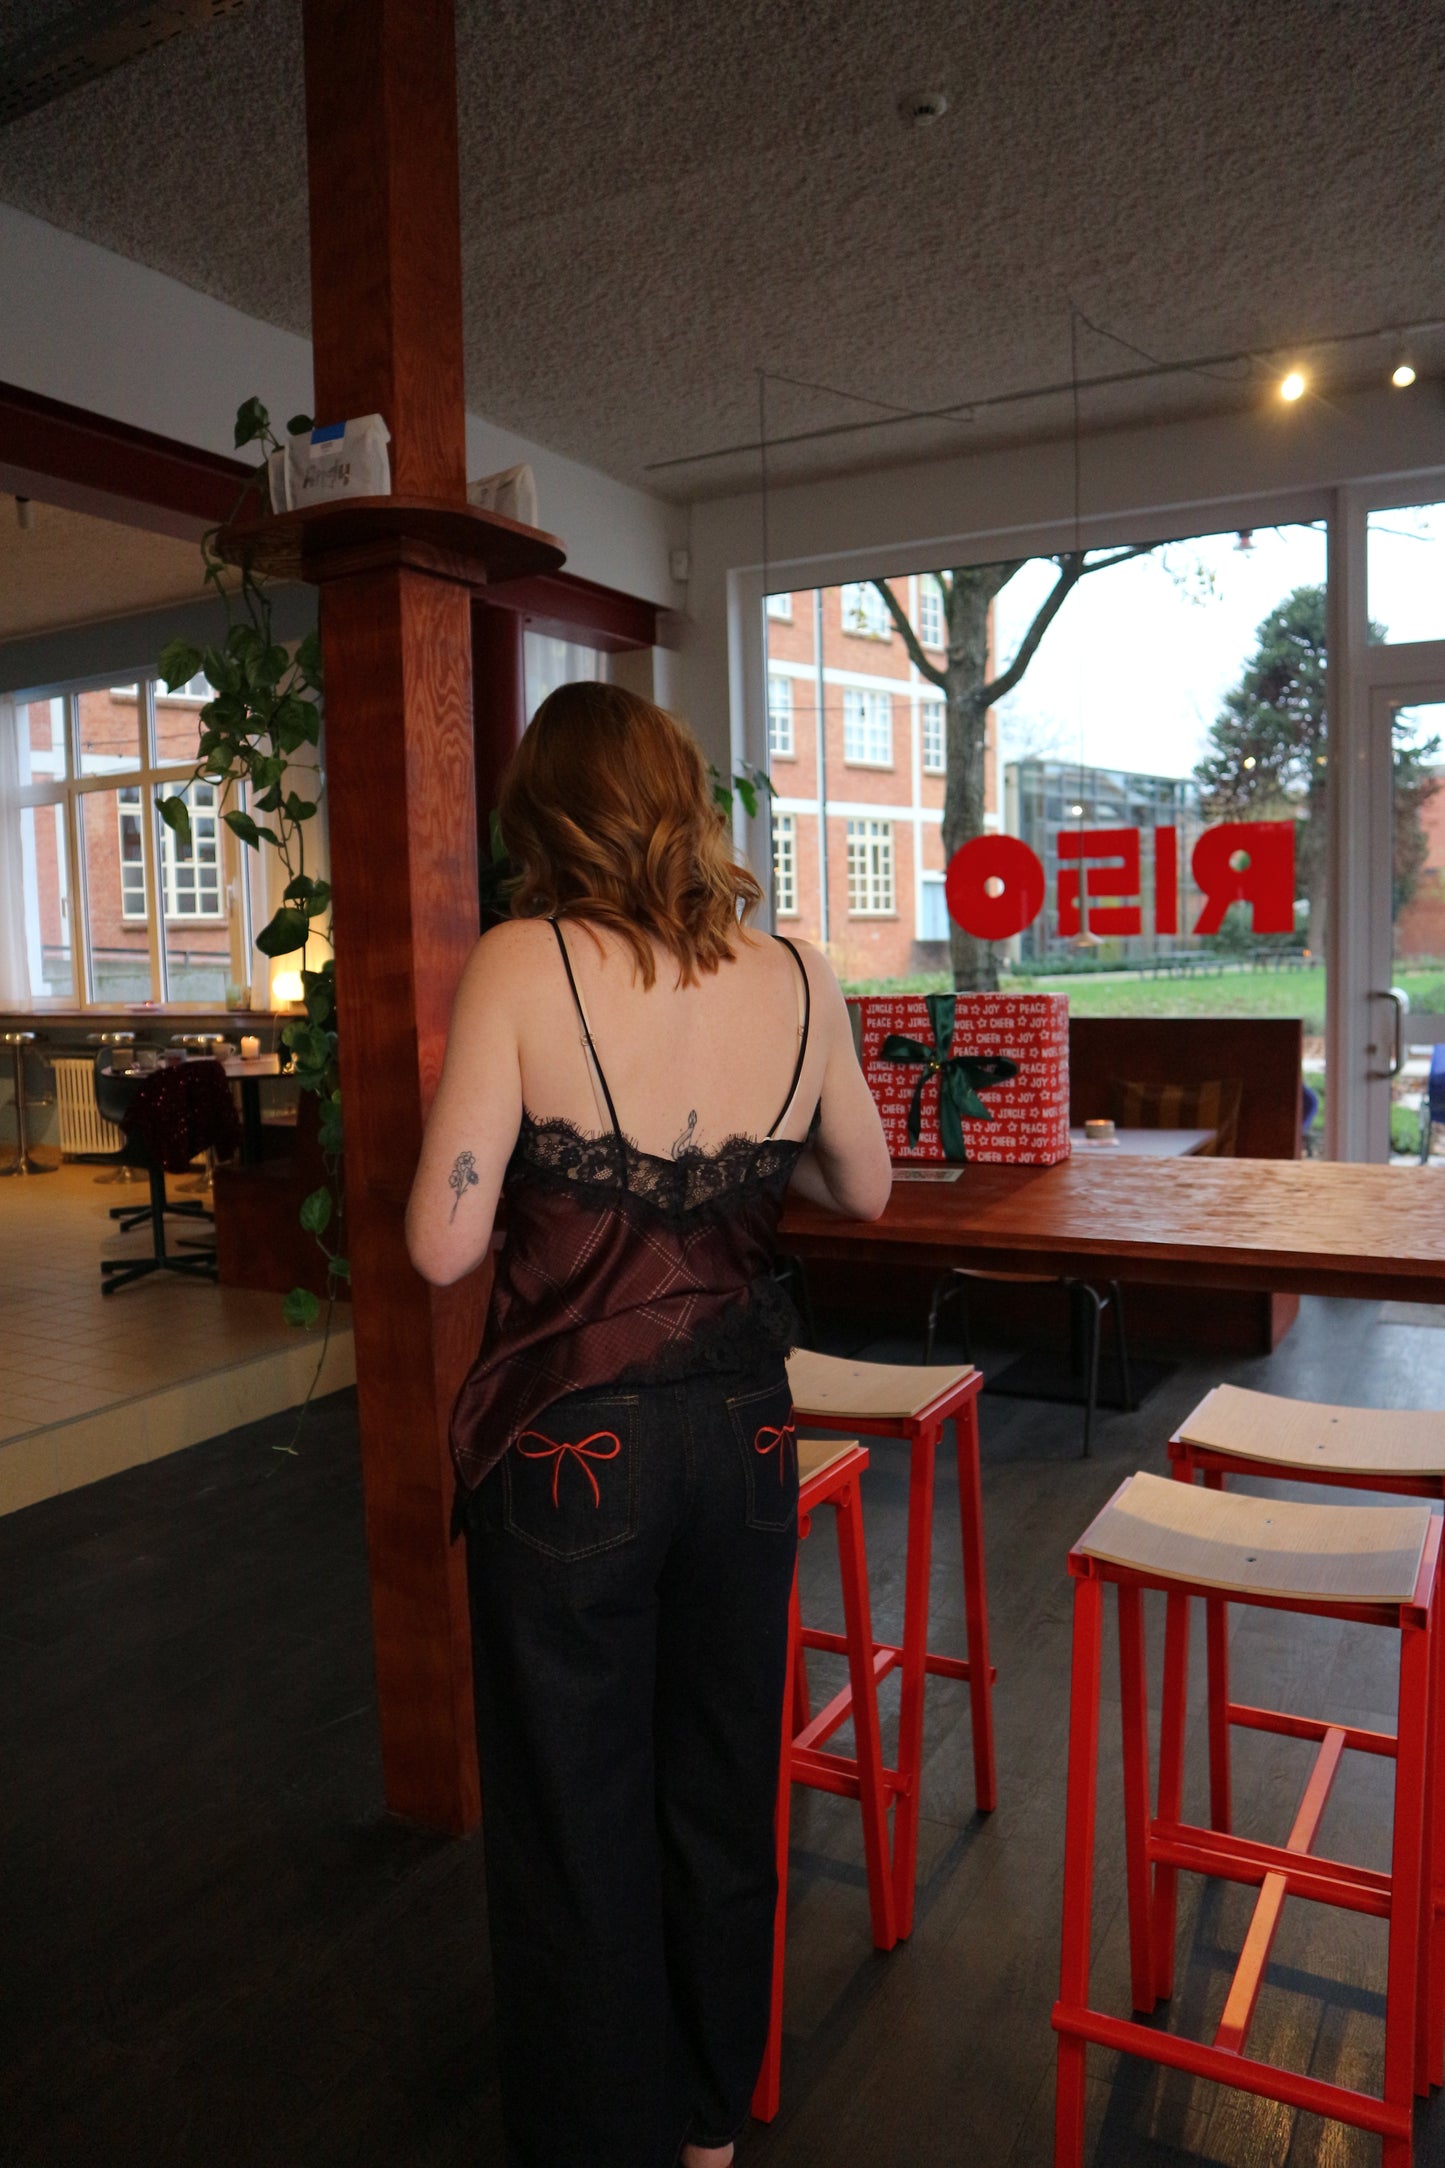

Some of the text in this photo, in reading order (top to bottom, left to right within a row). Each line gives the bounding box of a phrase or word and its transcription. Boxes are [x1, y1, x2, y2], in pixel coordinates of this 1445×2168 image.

[866, 1003, 893, 1014] JINGLE
[982, 1004, 1000, 1015] JOY
[1019, 1003, 1046, 1014] PEACE
[866, 1018, 891, 1028] PEACE
[907, 1018, 931, 1028] JINGL
[989, 1018, 1014, 1028] CHEER
[1030, 1017, 1047, 1028] JOY
[864, 1033, 879, 1043] ACE
[976, 1033, 1001, 1044] CHEER
[1017, 1033, 1035, 1043] JOY
[953, 1046, 979, 1057] PEACE
[867, 1061, 894, 1071] JINGLE
[909, 1063, 924, 1071] NOE
[1020, 1063, 1046, 1073] PEACE
[867, 1073, 893, 1083] PEACE
[1030, 1077, 1047, 1087] JOY
[977, 1092, 1002, 1102] CHEER
[1017, 1092, 1035, 1103] JOY
[881, 1104, 905, 1114] CHEER
[920, 1105, 936, 1115] JOY
[998, 1108, 1026, 1119] JINGLE
[920, 1119, 930, 1128] EL
[985, 1122, 1002, 1132] JOY
[1021, 1122, 1047, 1133] PEACE
[991, 1136, 1016, 1147] CHEER
[1032, 1138, 1048, 1148] JOY
[977, 1152, 1002, 1162] CHEER
[1018, 1152, 1036, 1163] JOY
